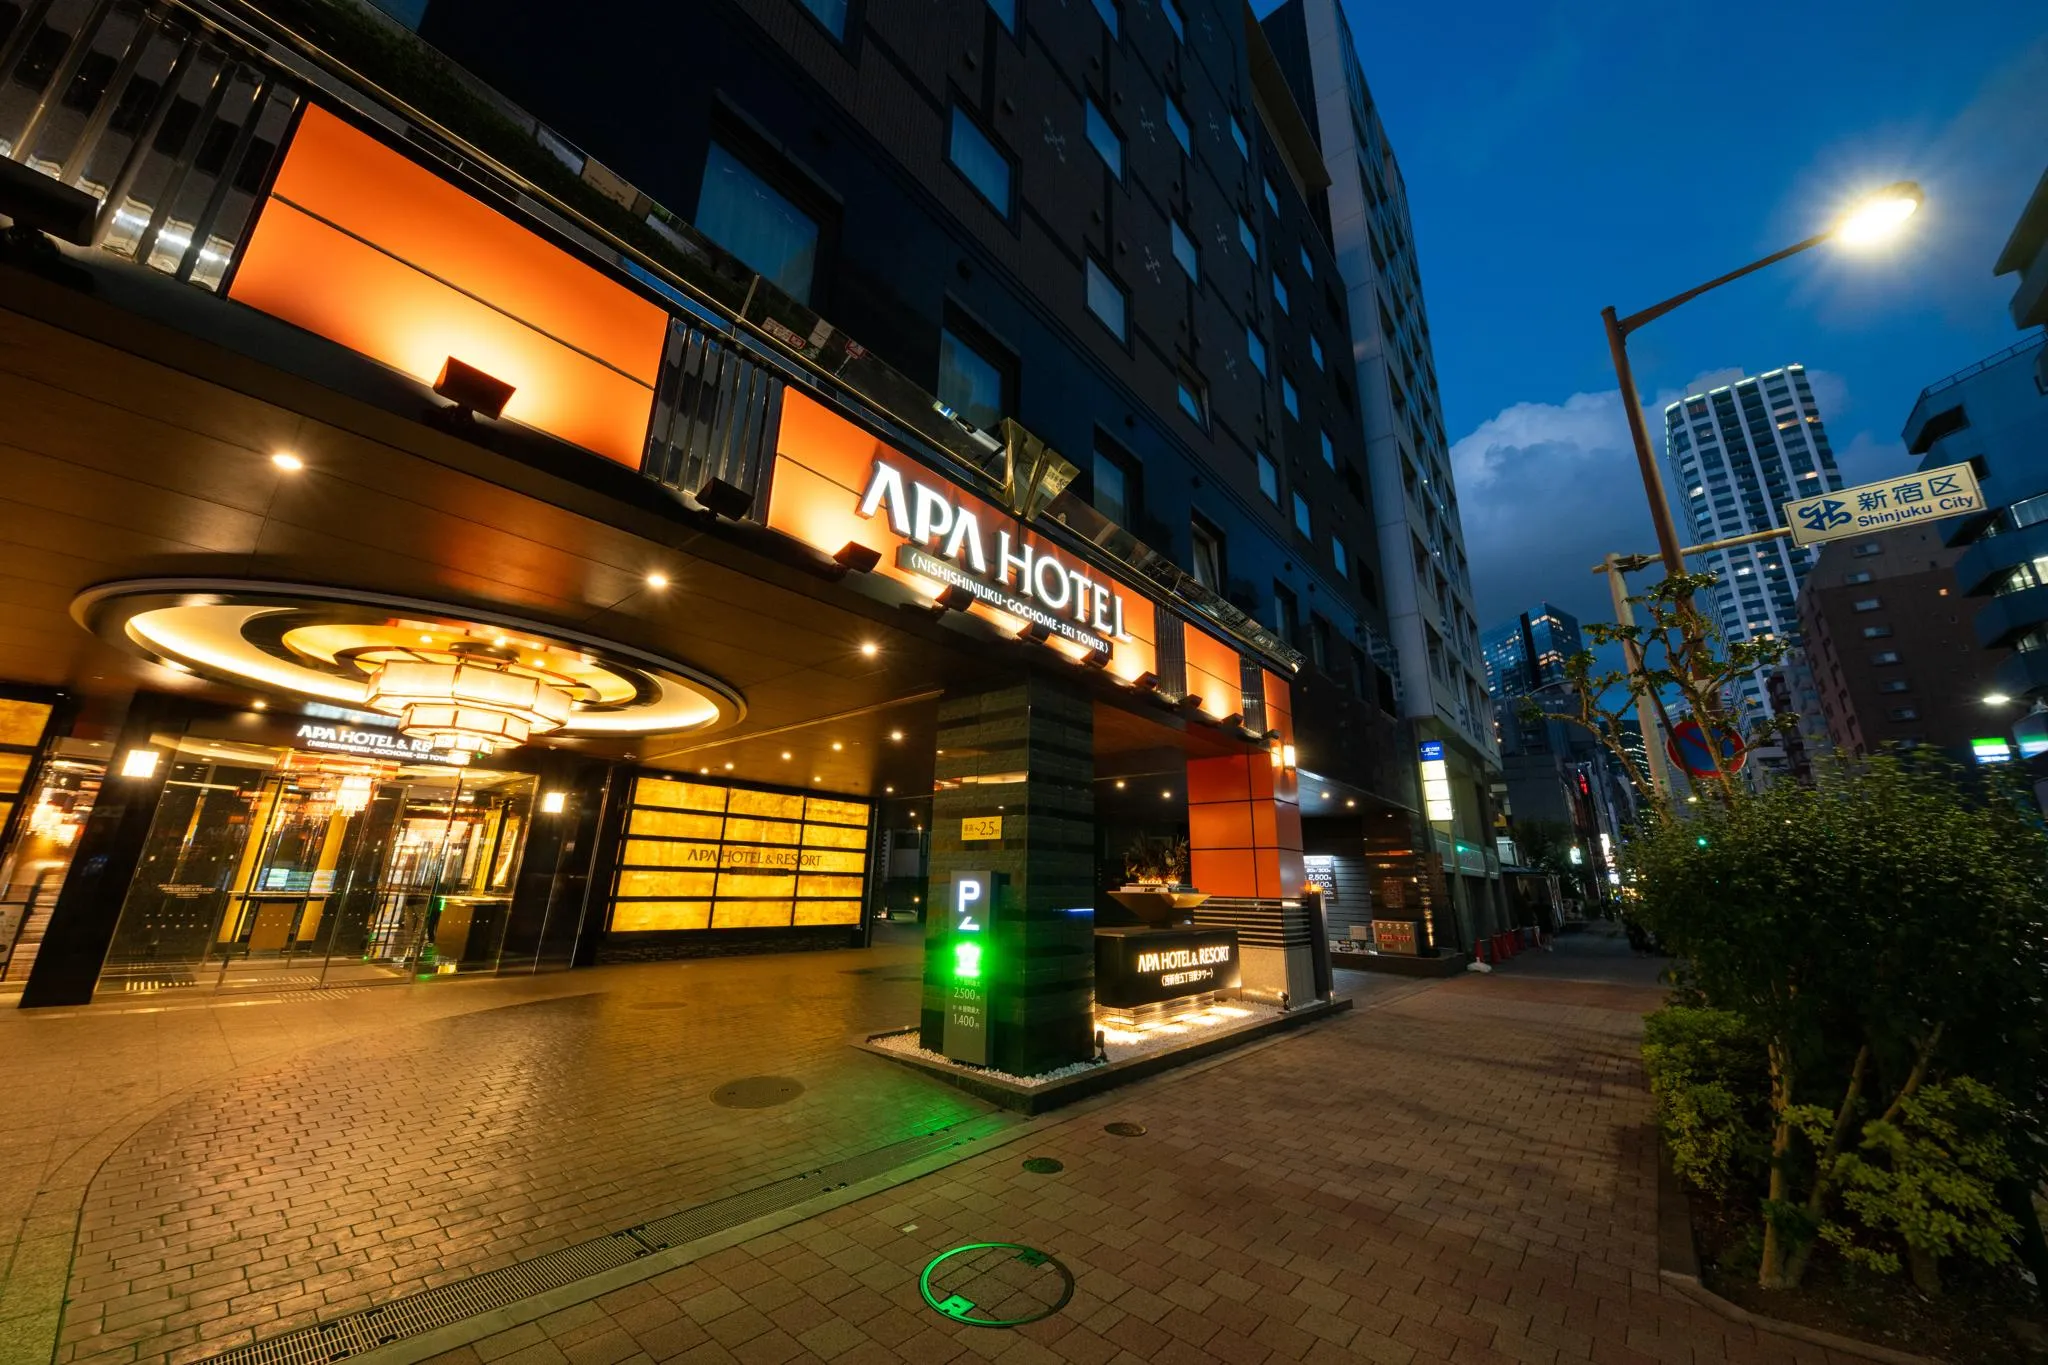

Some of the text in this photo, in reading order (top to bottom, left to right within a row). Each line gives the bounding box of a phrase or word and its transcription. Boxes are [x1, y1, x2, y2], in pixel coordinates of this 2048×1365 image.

[1857, 473, 1963, 512] 新宿区
[1857, 495, 1973, 527] Shinjuku City
[859, 460, 1132, 643] APA HOTEL
[297, 725, 336, 741] APA
[339, 730, 396, 749] HOTEL
[397, 739, 408, 750] &
[687, 849, 822, 866] APA HOTEL & RESORT
[958, 880, 981, 912] P
[1139, 946, 1229, 973] APA HOTEL & RESORT
